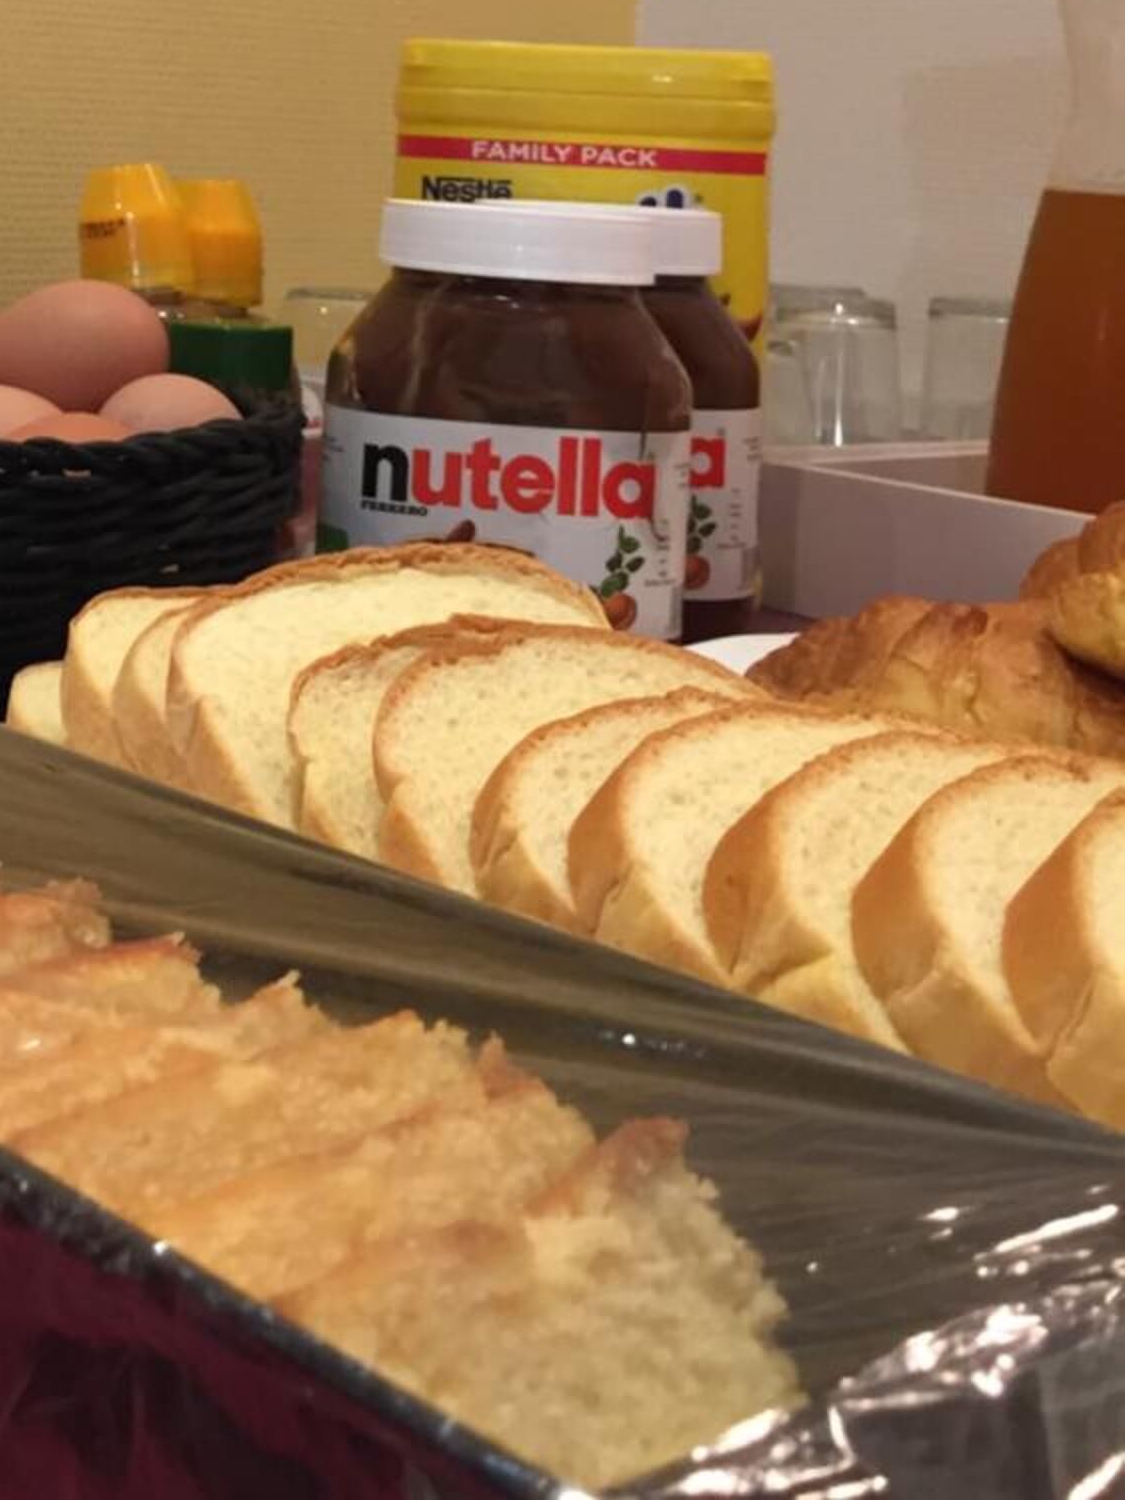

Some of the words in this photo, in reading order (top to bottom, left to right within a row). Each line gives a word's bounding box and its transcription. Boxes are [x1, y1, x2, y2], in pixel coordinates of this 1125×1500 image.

[472, 140, 573, 163] FAMILY
[581, 147, 658, 167] PACK
[361, 436, 657, 520] nutella
[360, 500, 428, 517] FERRERO
